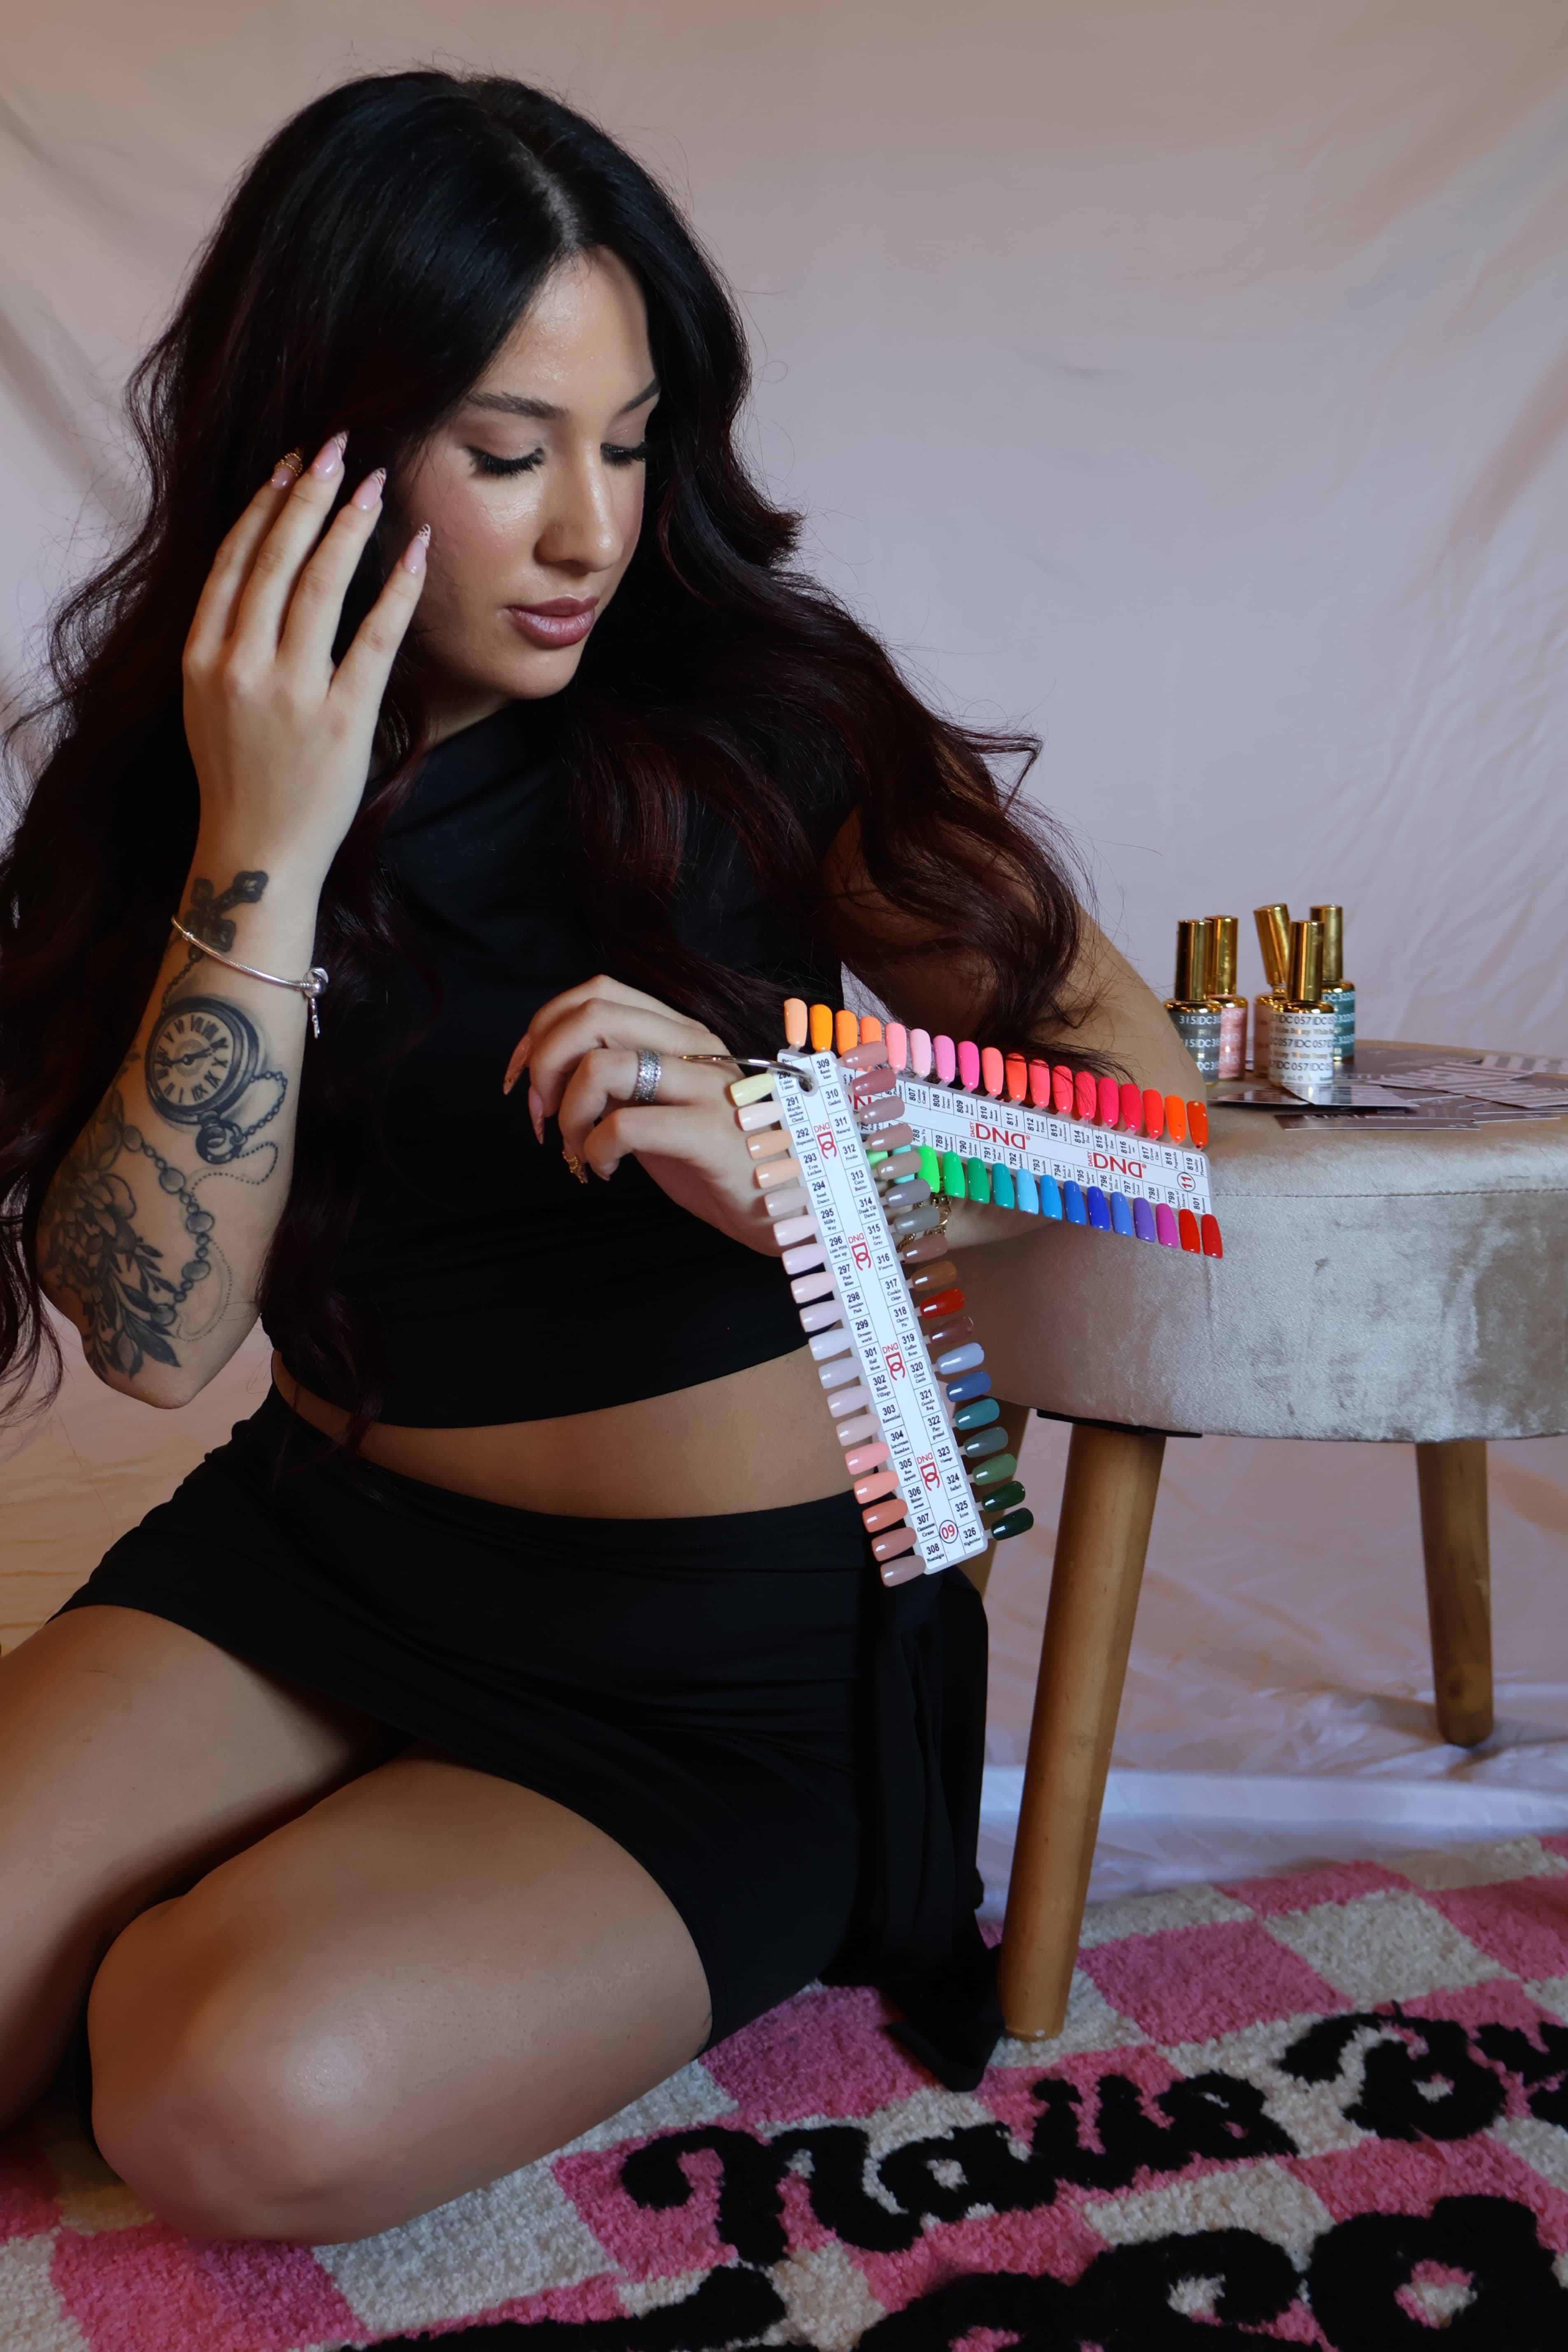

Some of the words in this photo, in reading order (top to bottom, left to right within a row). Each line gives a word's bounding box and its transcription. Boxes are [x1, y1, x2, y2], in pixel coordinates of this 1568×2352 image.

[817, 1059, 830, 1069] 309
[826, 1089, 838, 1099] 310
[786, 1096, 799, 1106] 291
[814, 1122, 831, 1132] DND
[835, 1116, 847, 1127] 311
[796, 1128, 809, 1138] 292
[843, 1144, 856, 1154] 312
[803, 1153, 817, 1164] 293
[851, 1170, 863, 1181] 313
[812, 1181, 825, 1191] 294
[1181, 1176, 1192, 1189] 11
[859, 1197, 872, 1207] 314
[821, 1208, 834, 1219] 295
[868, 1224, 880, 1234] 315
[829, 1236, 842, 1246] 296
[848, 1233, 864, 1244] DND
[877, 1253, 889, 1264] 316
[838, 1264, 850, 1275] 297
[886, 1278, 897, 1289] 317
[847, 1292, 860, 1303] 298
[894, 1306, 907, 1317] 318
[856, 1319, 868, 1330] 299
[902, 1333, 915, 1344] 319
[865, 1346, 877, 1358] 301
[882, 1342, 898, 1353] DND
[910, 1362, 923, 1372] 320
[873, 1374, 886, 1385] 302
[920, 1389, 932, 1400] 321
[882, 1405, 895, 1416] 303
[882, 1414, 901, 1423] Essential
[928, 1415, 940, 1426] 322
[891, 1430, 903, 1441] 304
[933, 1432, 945, 1440] ground
[938, 1446, 950, 1457] 323
[899, 1458, 912, 1469] 305
[917, 1453, 933, 1464] DND
[947, 1473, 959, 1484] 324
[908, 1486, 921, 1498] 306
[955, 1500, 968, 1512] 325
[917, 1513, 929, 1524] 307
[942, 1524, 955, 1539] 09
[964, 1527, 976, 1538] 326
[964, 1537, 981, 1546] Nightrider
[927, 1543, 940, 1554] 308
[927, 1553, 944, 1563] Nostalgia
